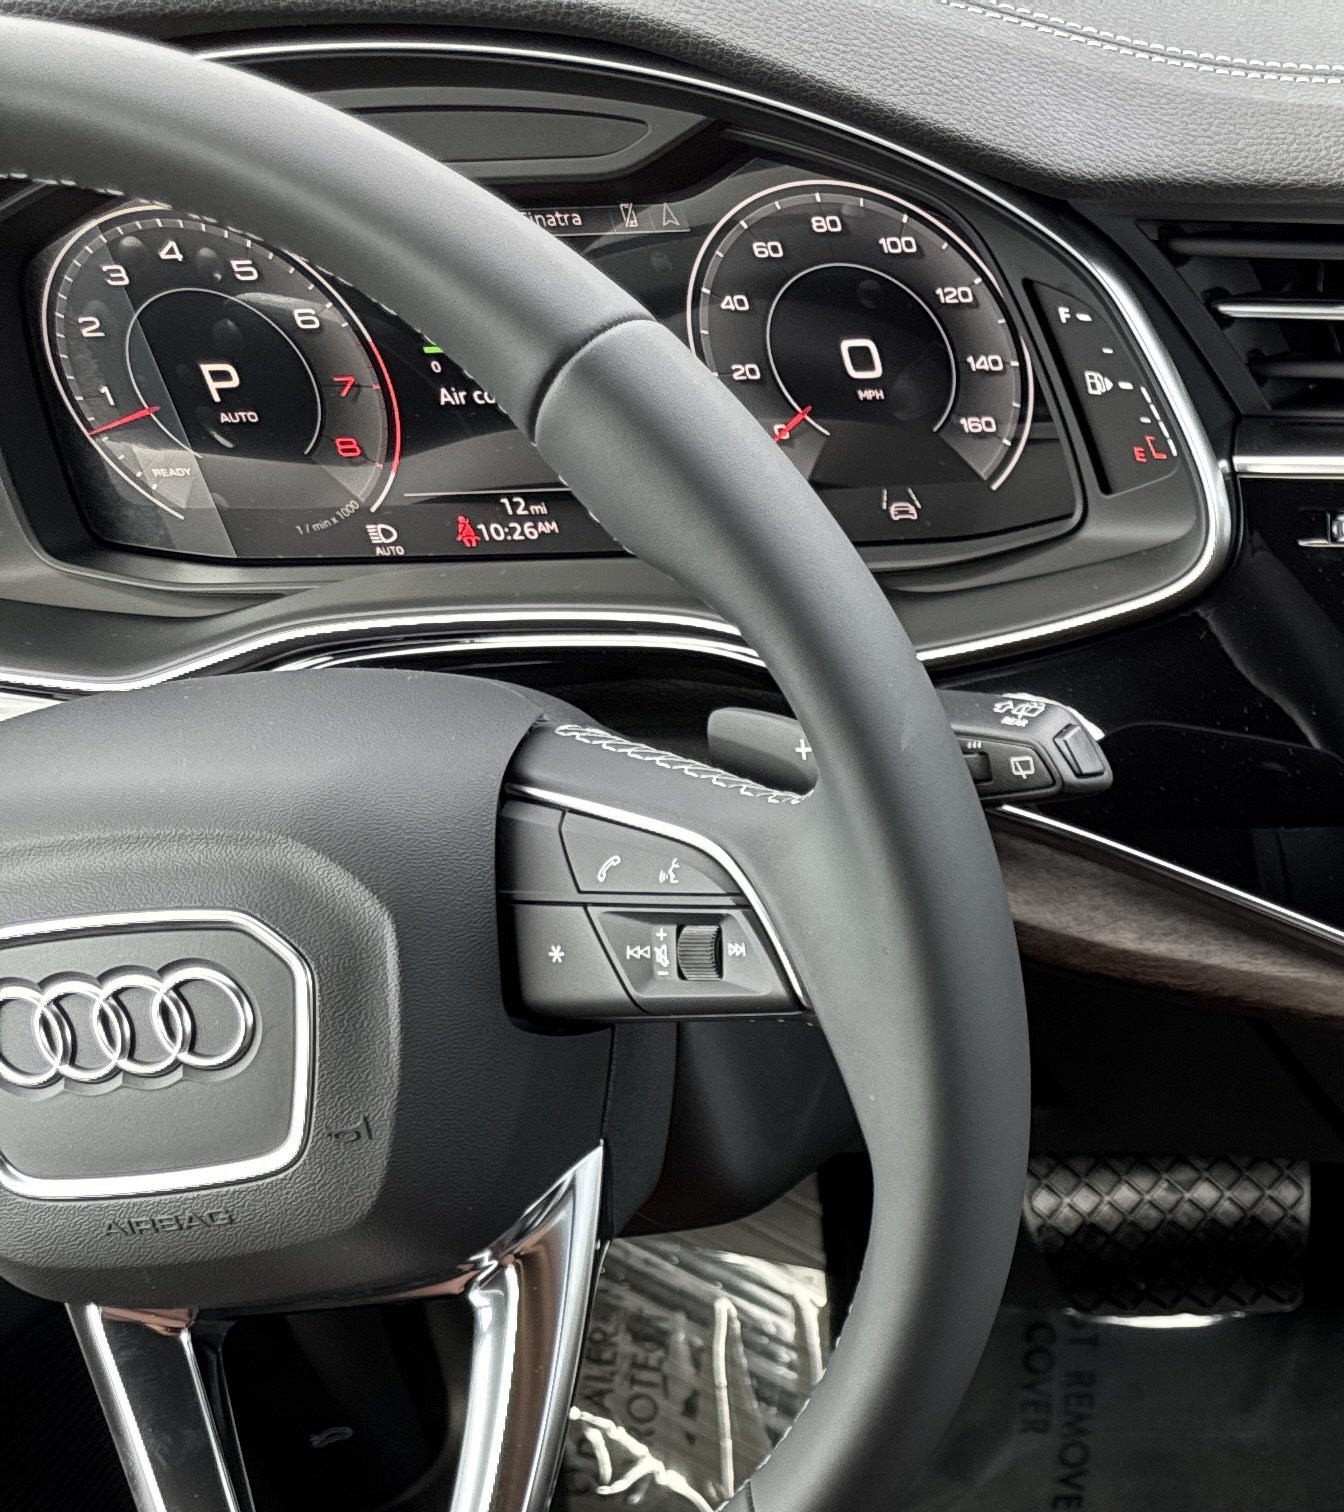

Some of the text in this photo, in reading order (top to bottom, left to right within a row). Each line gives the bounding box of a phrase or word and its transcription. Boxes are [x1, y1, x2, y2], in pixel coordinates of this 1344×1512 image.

[520, 210, 582, 227] inatra
[811, 216, 841, 232] 80
[159, 241, 183, 261] 4
[753, 241, 783, 258] 60
[879, 236, 917, 253] 100
[103, 263, 130, 286] 3
[231, 259, 257, 280] 5
[720, 295, 749, 310] 40
[936, 286, 973, 303] 120
[294, 307, 319, 329] 6
[1059, 307, 1071, 323] F
[78, 317, 104, 337] 2
[840, 338, 882, 379] 0
[967, 354, 1003, 371] 140
[731, 364, 760, 380] 20
[200, 362, 241, 402] P
[334, 376, 354, 397] 7
[100, 385, 115, 406] 1
[440, 387, 466, 406] Air
[857, 389, 884, 401] MPH
[220, 411, 258, 423] AUTO
[960, 416, 996, 433] 160
[335, 438, 360, 458] 8
[1134, 446, 1147, 462] E
[152, 467, 191, 478] READY
[335, 499, 360, 521] 1000
[500, 496, 528, 516] 12
[478, 519, 559, 541] 10:26 AM
[376, 546, 405, 556] AUTO
[104, 1209, 236, 1239] AIRBAG
[1018, 1321, 1057, 1436] COVER
[1051, 1370, 1096, 1511] REMOVE
